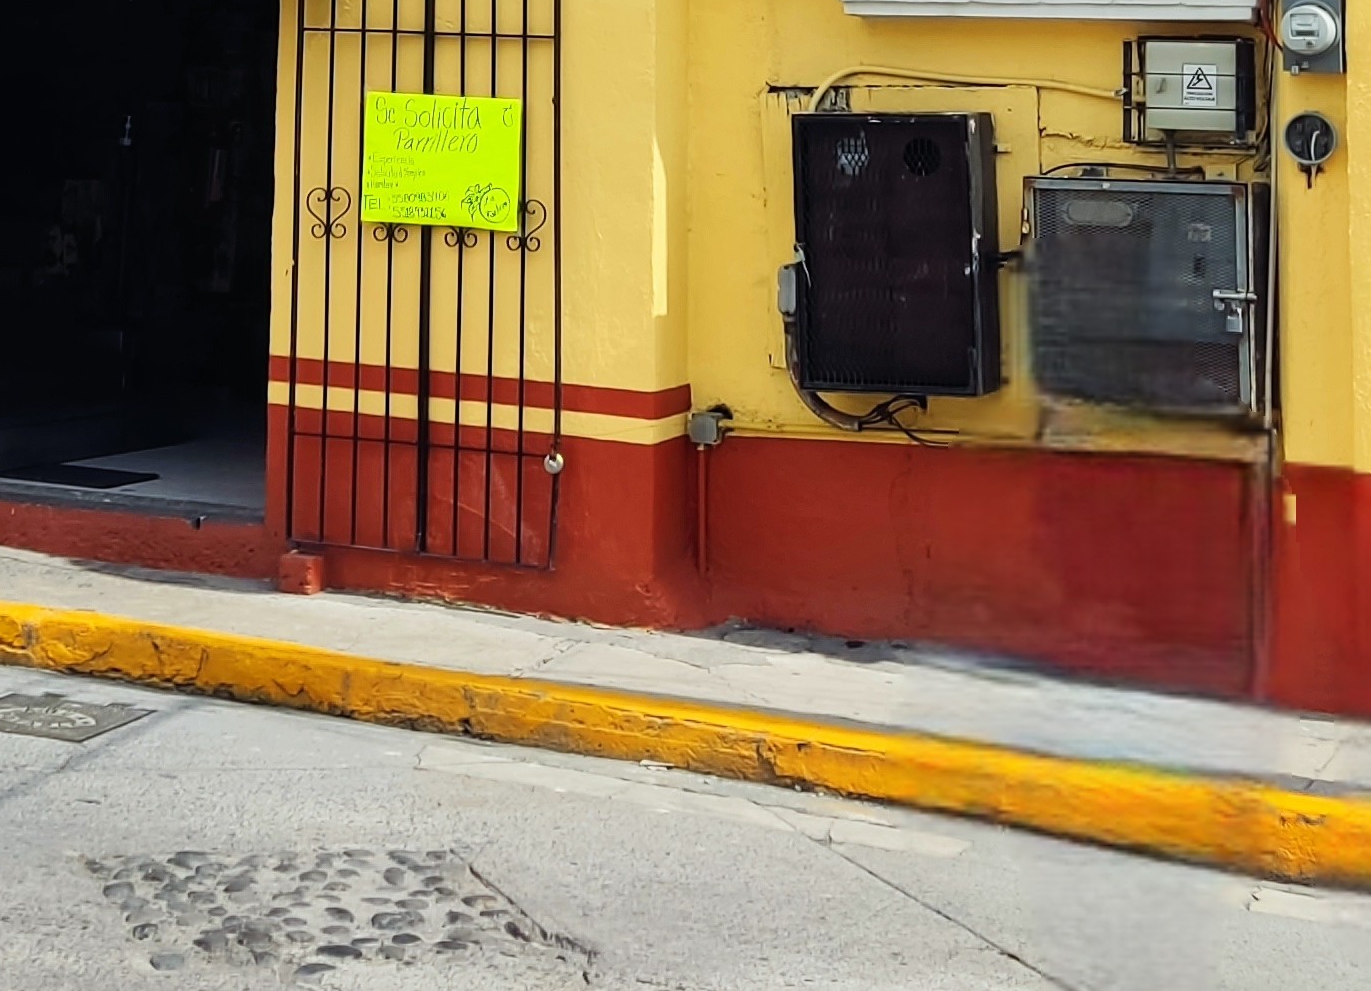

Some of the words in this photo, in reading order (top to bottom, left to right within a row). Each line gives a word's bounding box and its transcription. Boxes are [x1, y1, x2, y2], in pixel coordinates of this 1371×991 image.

[375, 96, 396, 125] Se
[404, 98, 482, 130] Solicita
[393, 127, 479, 153] Parrillero
